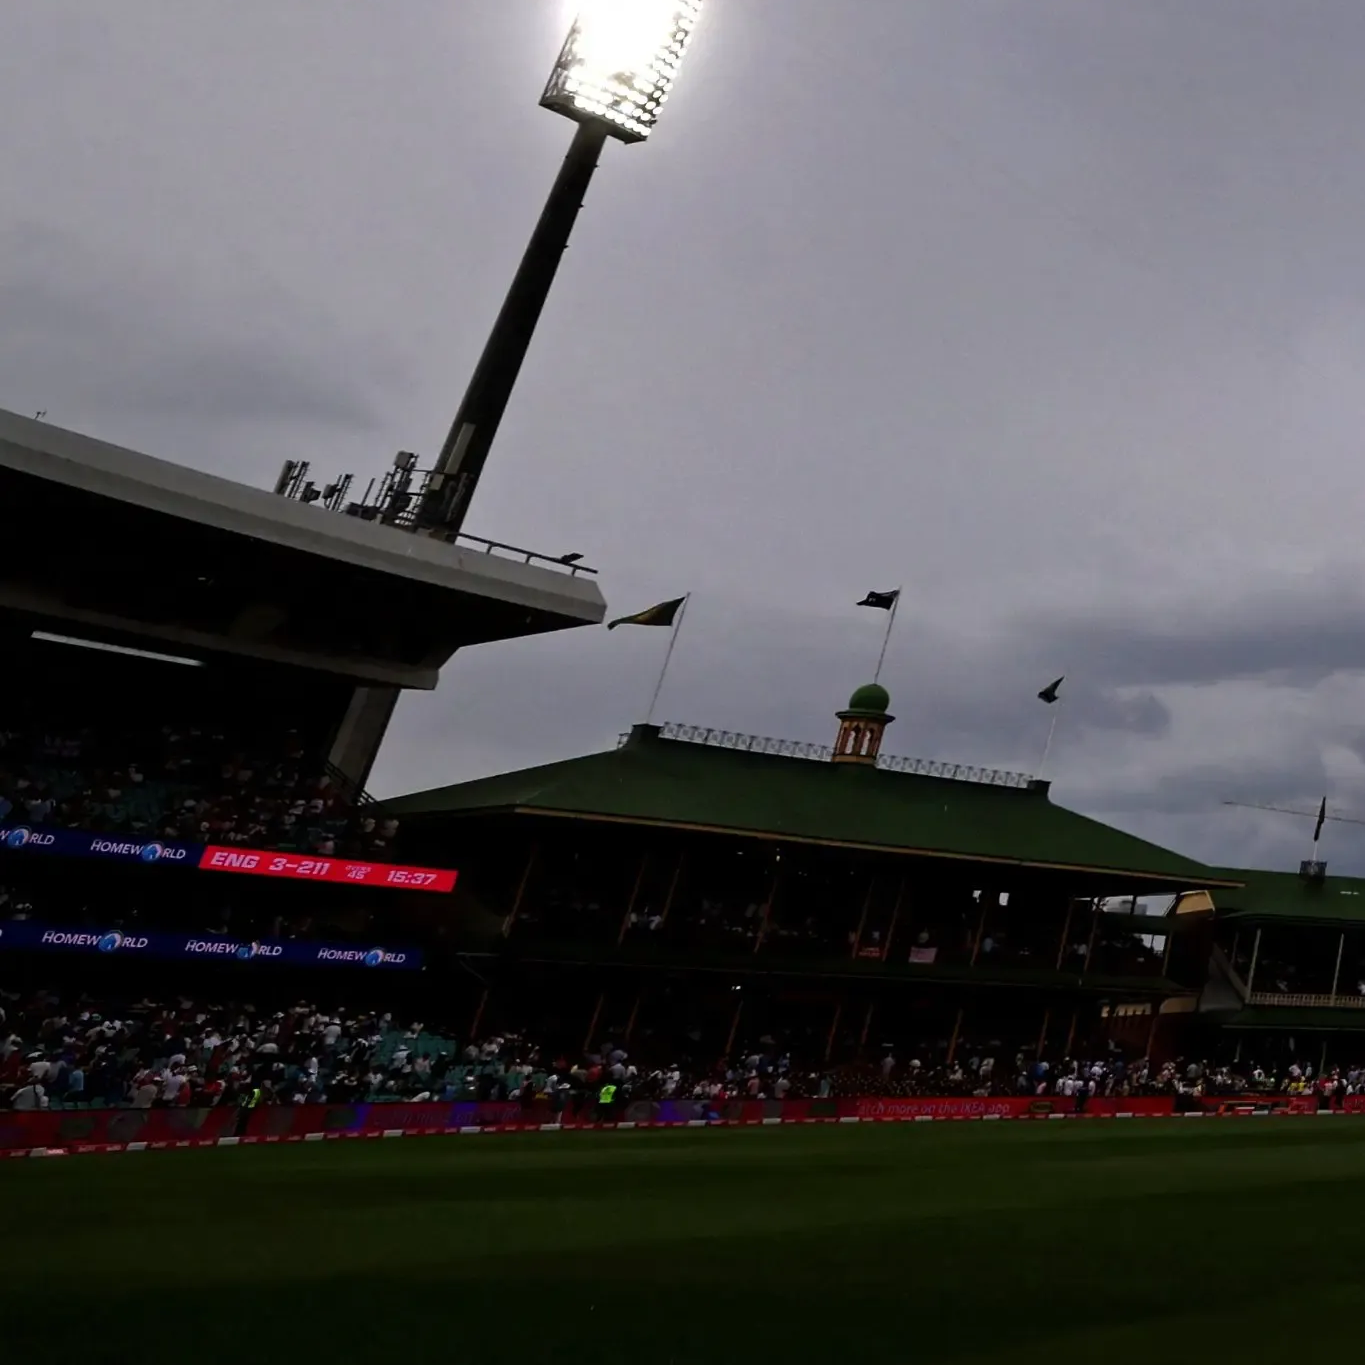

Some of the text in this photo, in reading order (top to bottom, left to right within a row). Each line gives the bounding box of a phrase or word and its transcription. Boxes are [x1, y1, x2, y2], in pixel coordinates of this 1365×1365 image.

[90, 838, 187, 862] HOMEWORLD
[210, 851, 331, 876] ENG 3-211
[347, 871, 365, 880] 45
[386, 870, 437, 885] 15:37
[41, 929, 148, 952] HOMEWORLD
[317, 946, 406, 966] HOMEWORLD
